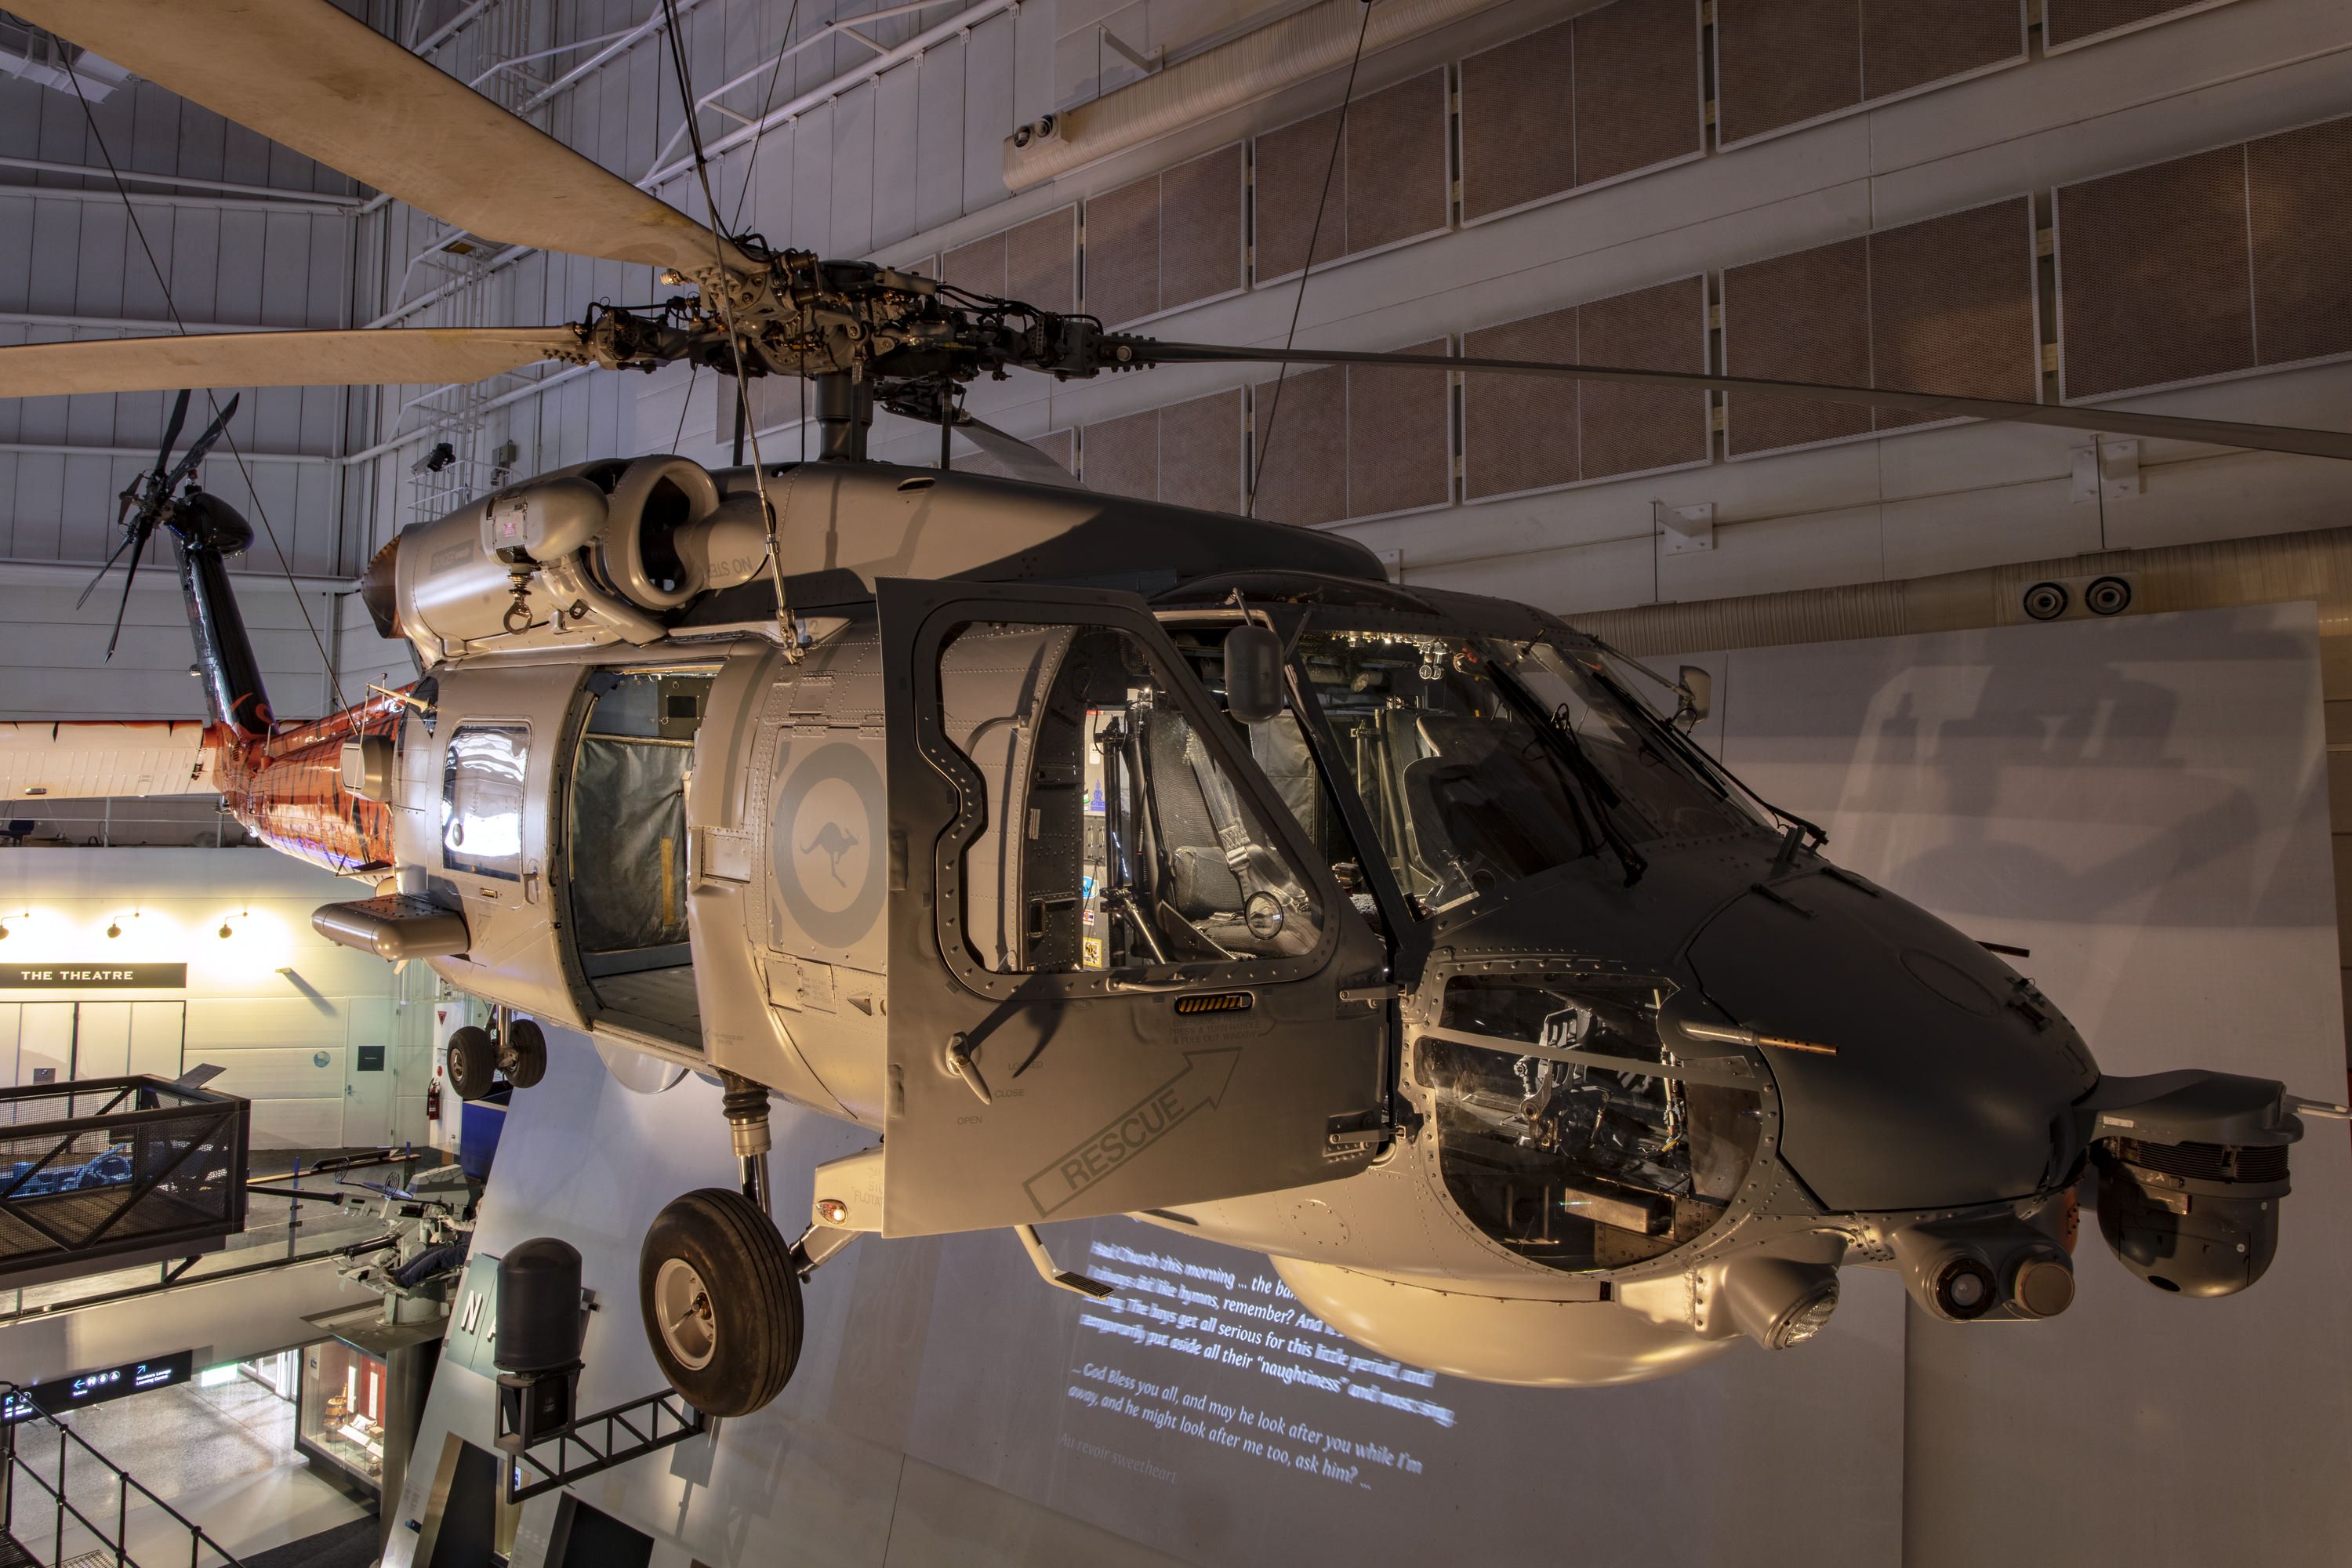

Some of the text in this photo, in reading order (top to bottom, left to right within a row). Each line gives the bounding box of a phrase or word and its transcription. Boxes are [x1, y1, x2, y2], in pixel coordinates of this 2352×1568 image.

[20, 971, 133, 980] THE THEATRE
[1169, 1028, 1196, 1036] PRESS
[1203, 1033, 1220, 1043] OUT
[994, 1088, 1025, 1098] CLOSE
[956, 1116, 982, 1125] OPEN
[1060, 1088, 1185, 1191] RESCUE
[1185, 1264, 1236, 1290] morning
[1251, 1276, 1271, 1294] the
[1178, 1283, 1220, 1310] hymns,
[1222, 1299, 1295, 1325] remember?
[1295, 1313, 1323, 1332] And
[1170, 1336, 1202, 1355] aside
[1203, 1344, 1221, 1360] all
[1222, 1348, 1254, 1368] their
[1176, 1315, 1198, 1330] get
[1200, 1317, 1218, 1332] all
[1218, 1323, 1261, 1345] serious
[1265, 1331, 1285, 1349] for
[1287, 1338, 1313, 1357] this
[1083, 1363, 1107, 1381] God
[1107, 1369, 1137, 1390] Bless
[1135, 1380, 1160, 1397] you
[1161, 1385, 1179, 1405] all,
[1182, 1394, 1207, 1411] and
[1208, 1400, 1236, 1423] may
[1239, 1406, 1254, 1425] he
[1258, 1411, 1285, 1435] look
[1288, 1422, 1323, 1445] after
[1323, 1434, 1352, 1454] you
[1355, 1442, 1396, 1467] while
[1068, 1385, 1098, 1407] away,
[1100, 1394, 1125, 1412] and
[1124, 1399, 1140, 1417] he
[1142, 1408, 1178, 1429] might
[1179, 1416, 1206, 1439] look
[1208, 1427, 1241, 1448] after
[1243, 1438, 1263, 1456] me
[1266, 1444, 1291, 1468] too,
[1295, 1454, 1319, 1474] ask
[1322, 1457, 1359, 1484] him?
[1059, 1433, 1178, 1484] Au revoir sweetheart
